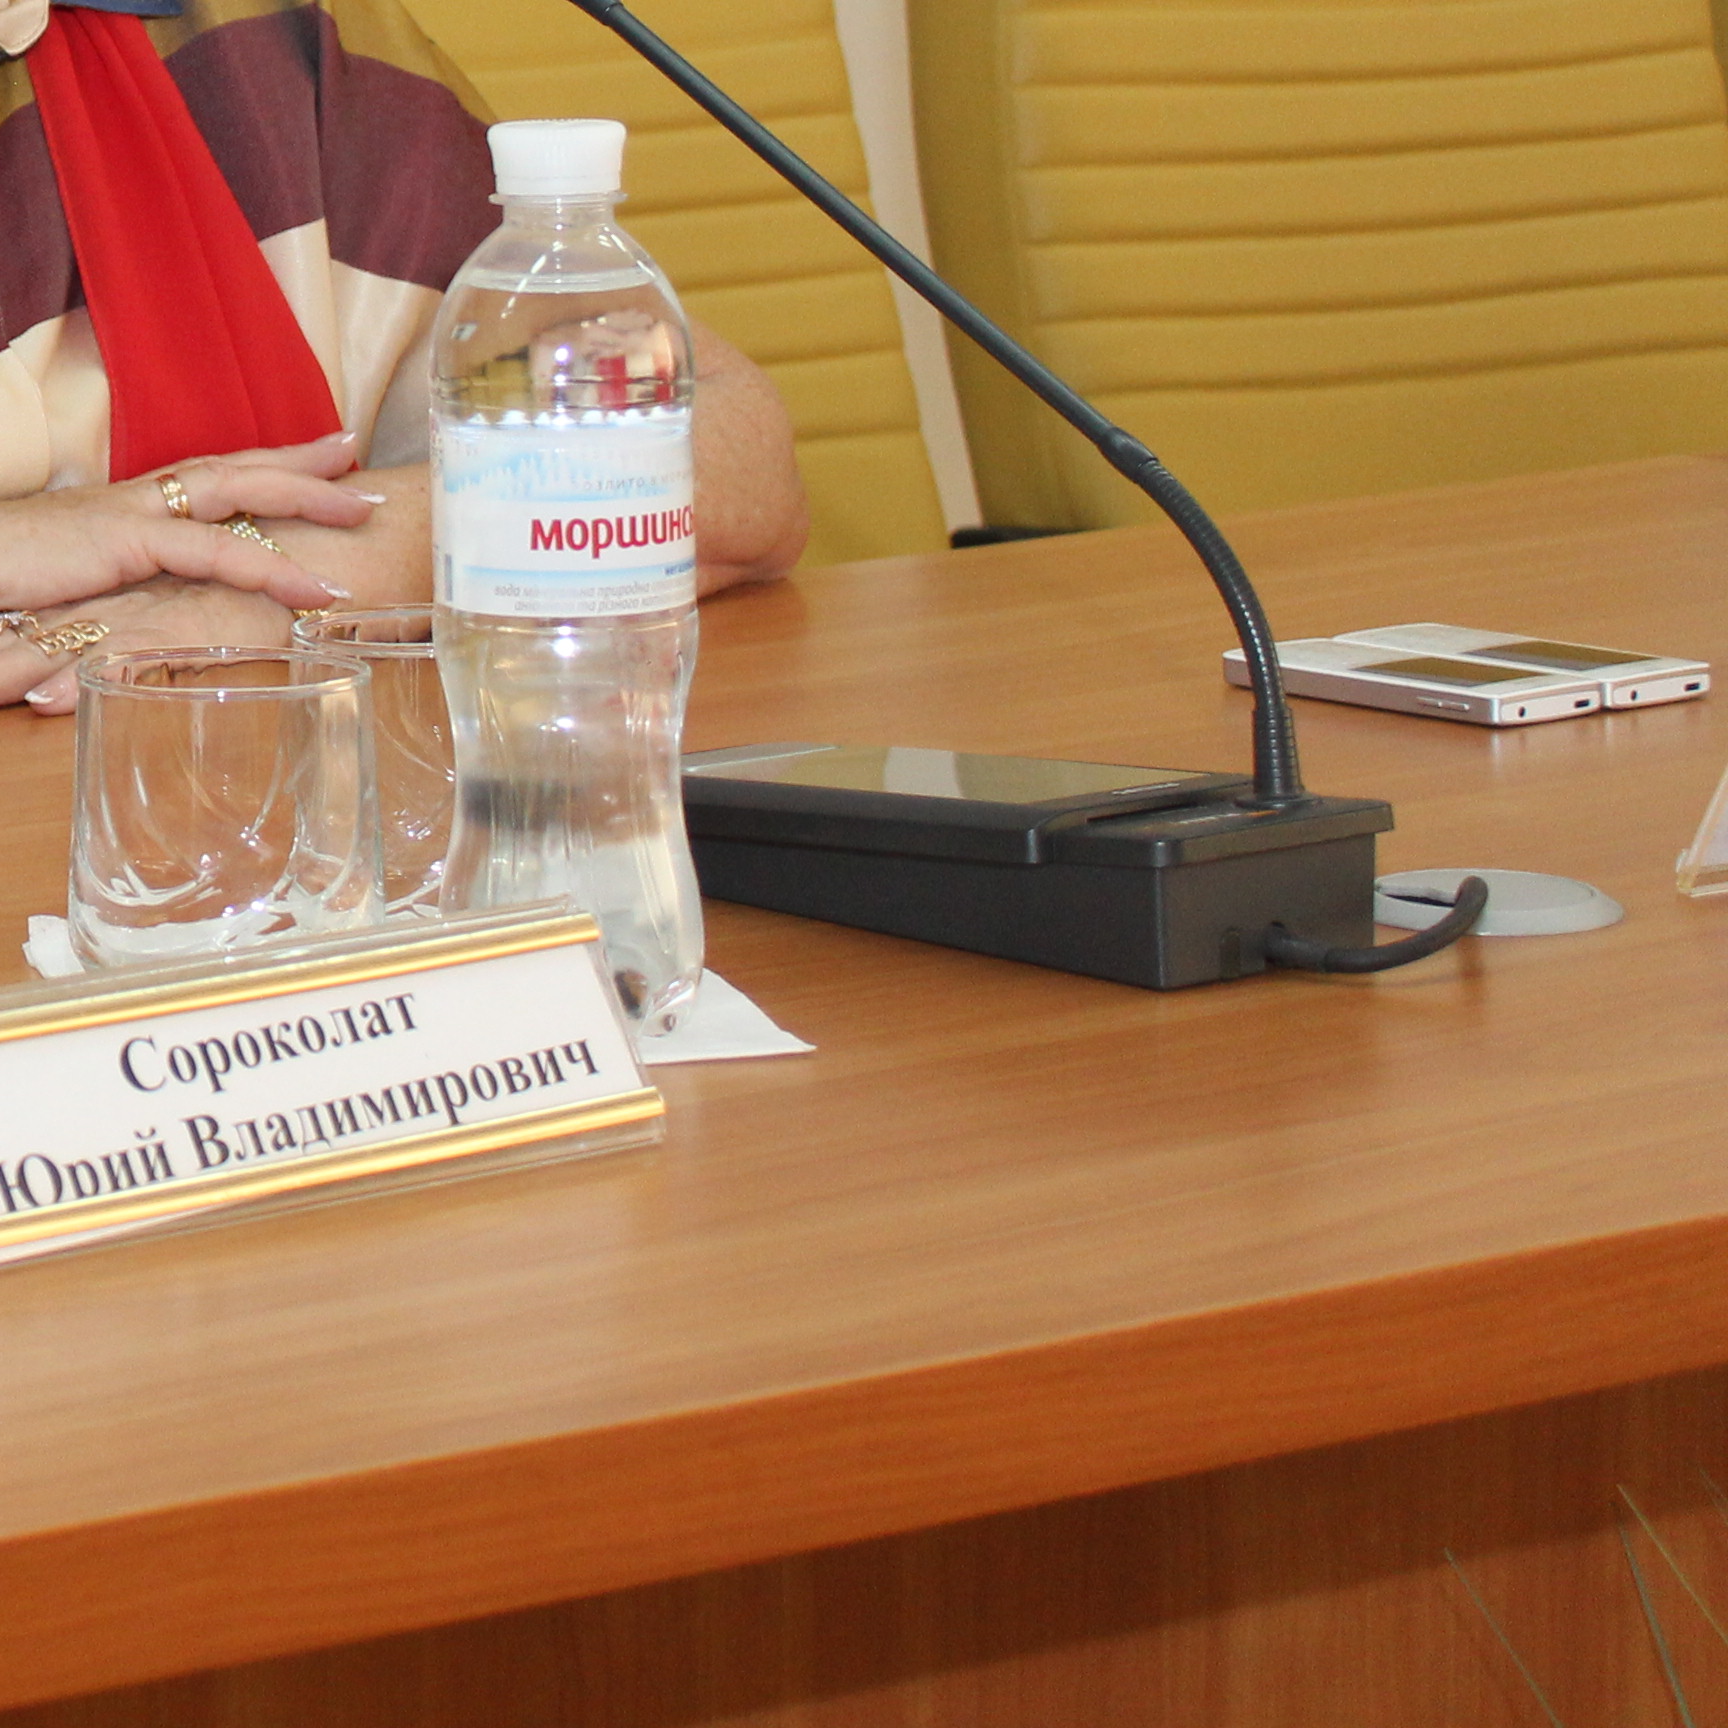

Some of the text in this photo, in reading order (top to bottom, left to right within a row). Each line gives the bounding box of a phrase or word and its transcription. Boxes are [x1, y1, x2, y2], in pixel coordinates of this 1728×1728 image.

[530, 504, 694, 559] моршинс
[118, 990, 420, 1095] Сороколат
[183, 1037, 600, 1172] Владимирович
